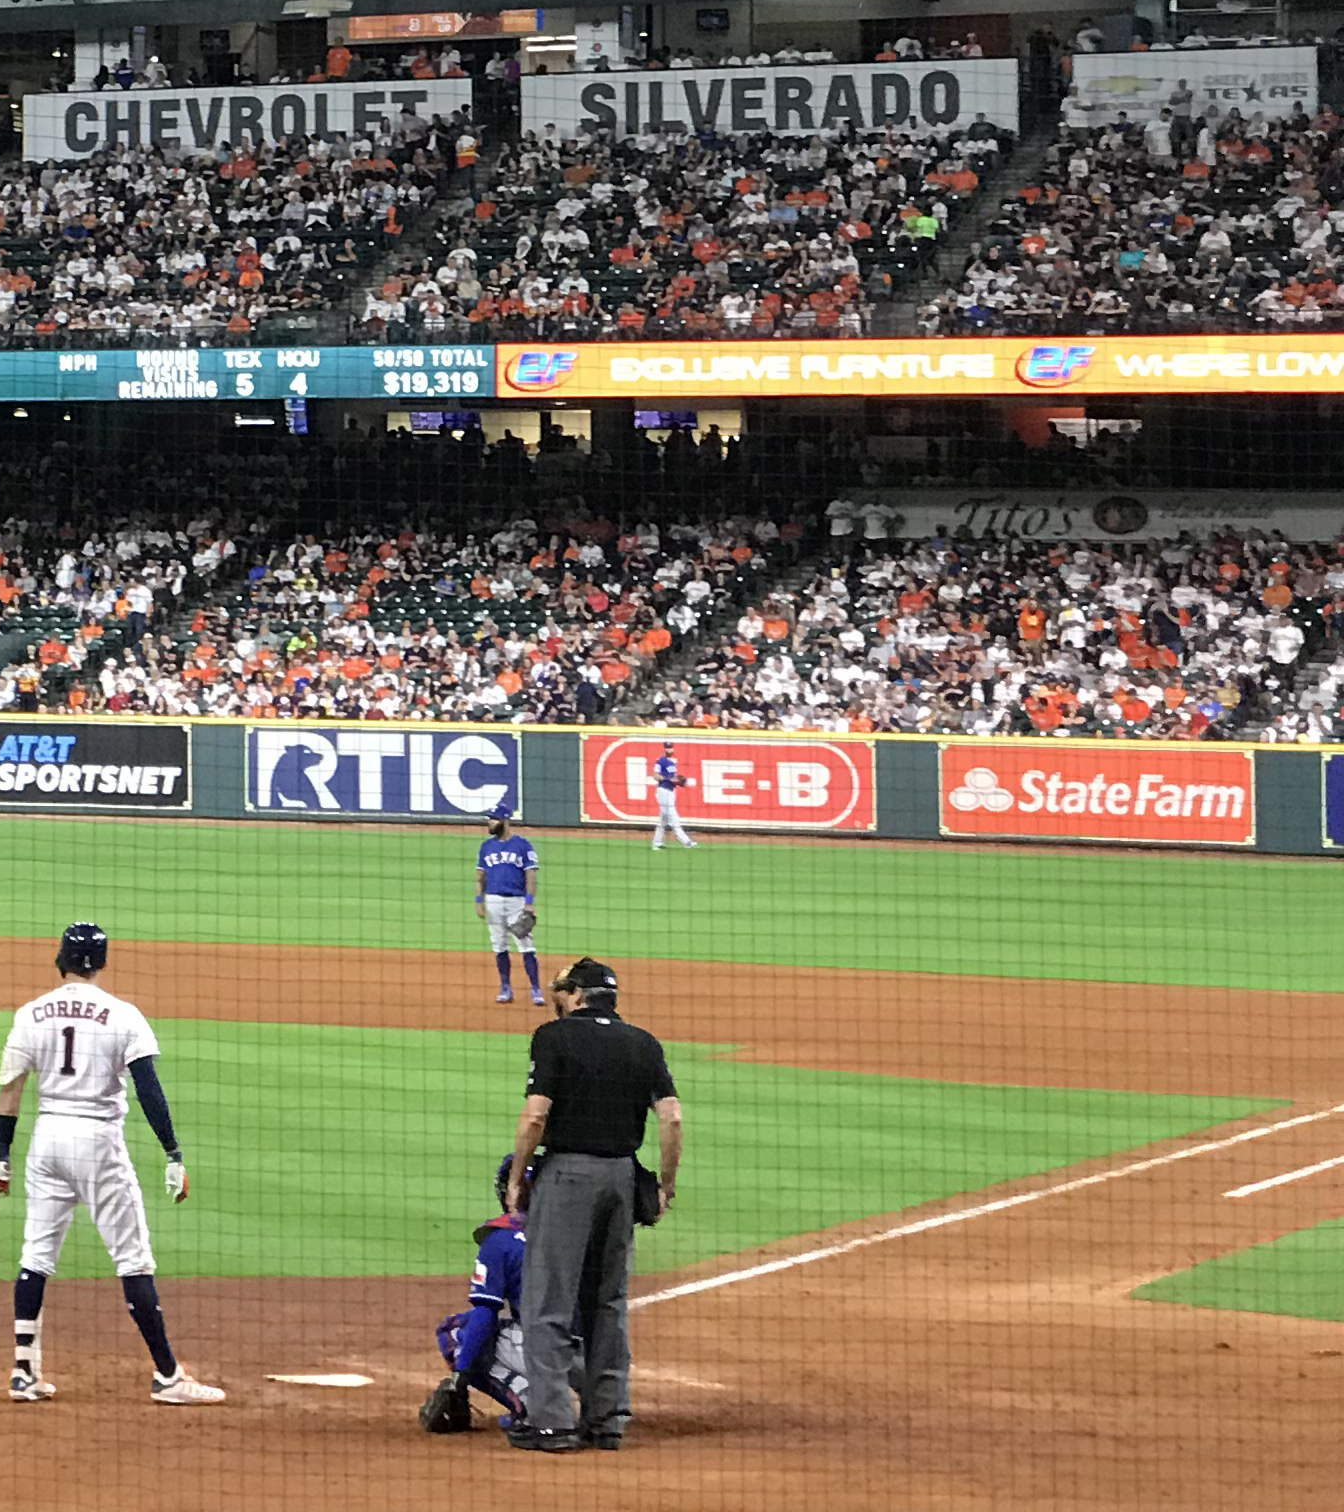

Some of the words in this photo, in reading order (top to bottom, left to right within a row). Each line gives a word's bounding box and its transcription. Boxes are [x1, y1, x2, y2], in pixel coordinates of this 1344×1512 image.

[579, 70, 962, 136] SILVERADO
[63, 90, 429, 153] CHEVROLET
[60, 355, 98, 372] MPH
[225, 350, 262, 369] TEX
[277, 349, 320, 368] HOU
[430, 348, 488, 367] TOTAL
[611, 355, 791, 382] EXCLUSIVE
[801, 354, 994, 380] FURNITURE
[1114, 354, 1250, 377] WHERE
[143, 366, 198, 383] VISITS
[235, 373, 254, 397] 5
[289, 372, 308, 396] 4
[383, 372, 479, 396] $19,319
[118, 381, 218, 399] REMAINING
[954, 493, 1080, 536] Tito's
[256, 732, 509, 814] RTIC
[625, 755, 831, 807] H-E-B
[32, 1000, 110, 1026] CORREA
[60, 1026, 76, 1076] 1
